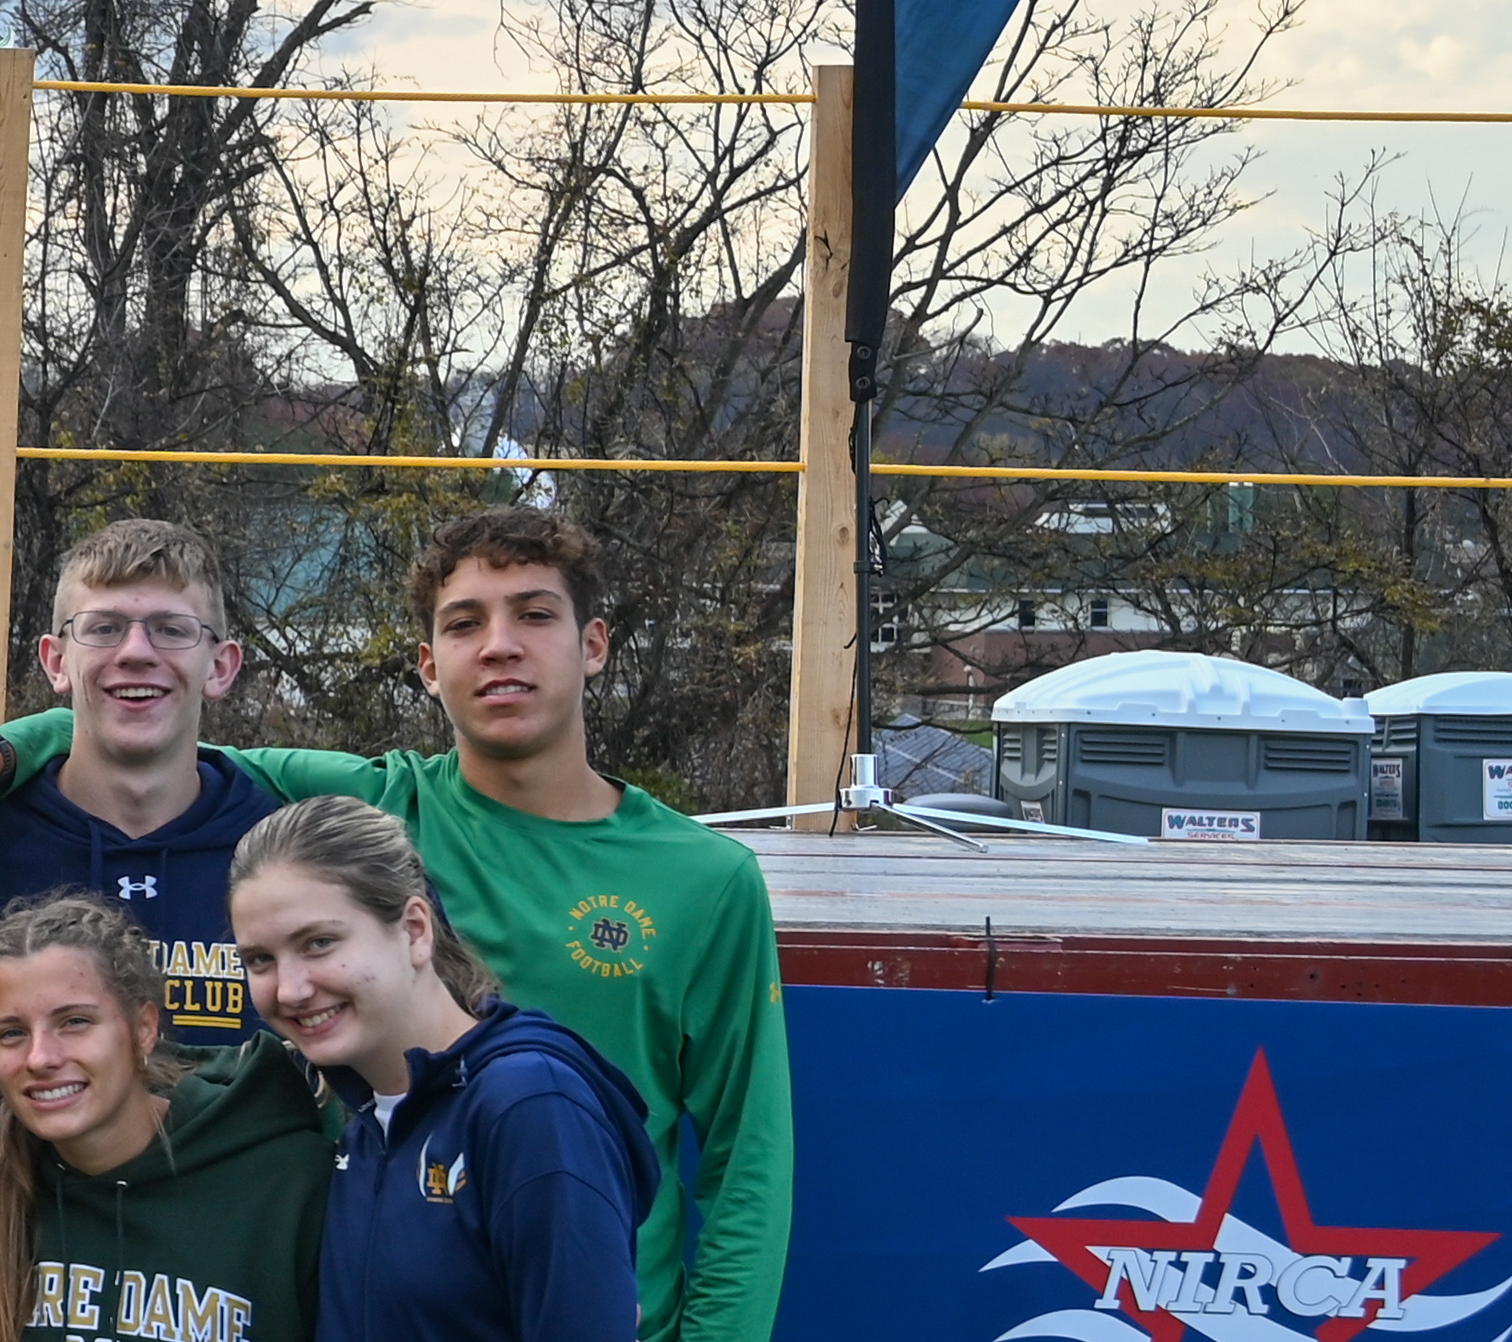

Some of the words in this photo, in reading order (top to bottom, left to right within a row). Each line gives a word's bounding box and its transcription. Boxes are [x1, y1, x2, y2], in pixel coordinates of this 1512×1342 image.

[1167, 815, 1255, 833] WALTERS
[569, 895, 619, 920] NOTRE
[624, 900, 657, 940] DAME
[146, 940, 244, 980] DAME
[566, 940, 644, 977] FOOTBALL
[164, 979, 243, 1014] CLUB
[25, 1261, 105, 1331] RE
[1093, 1248, 1409, 1322] NIRCA
